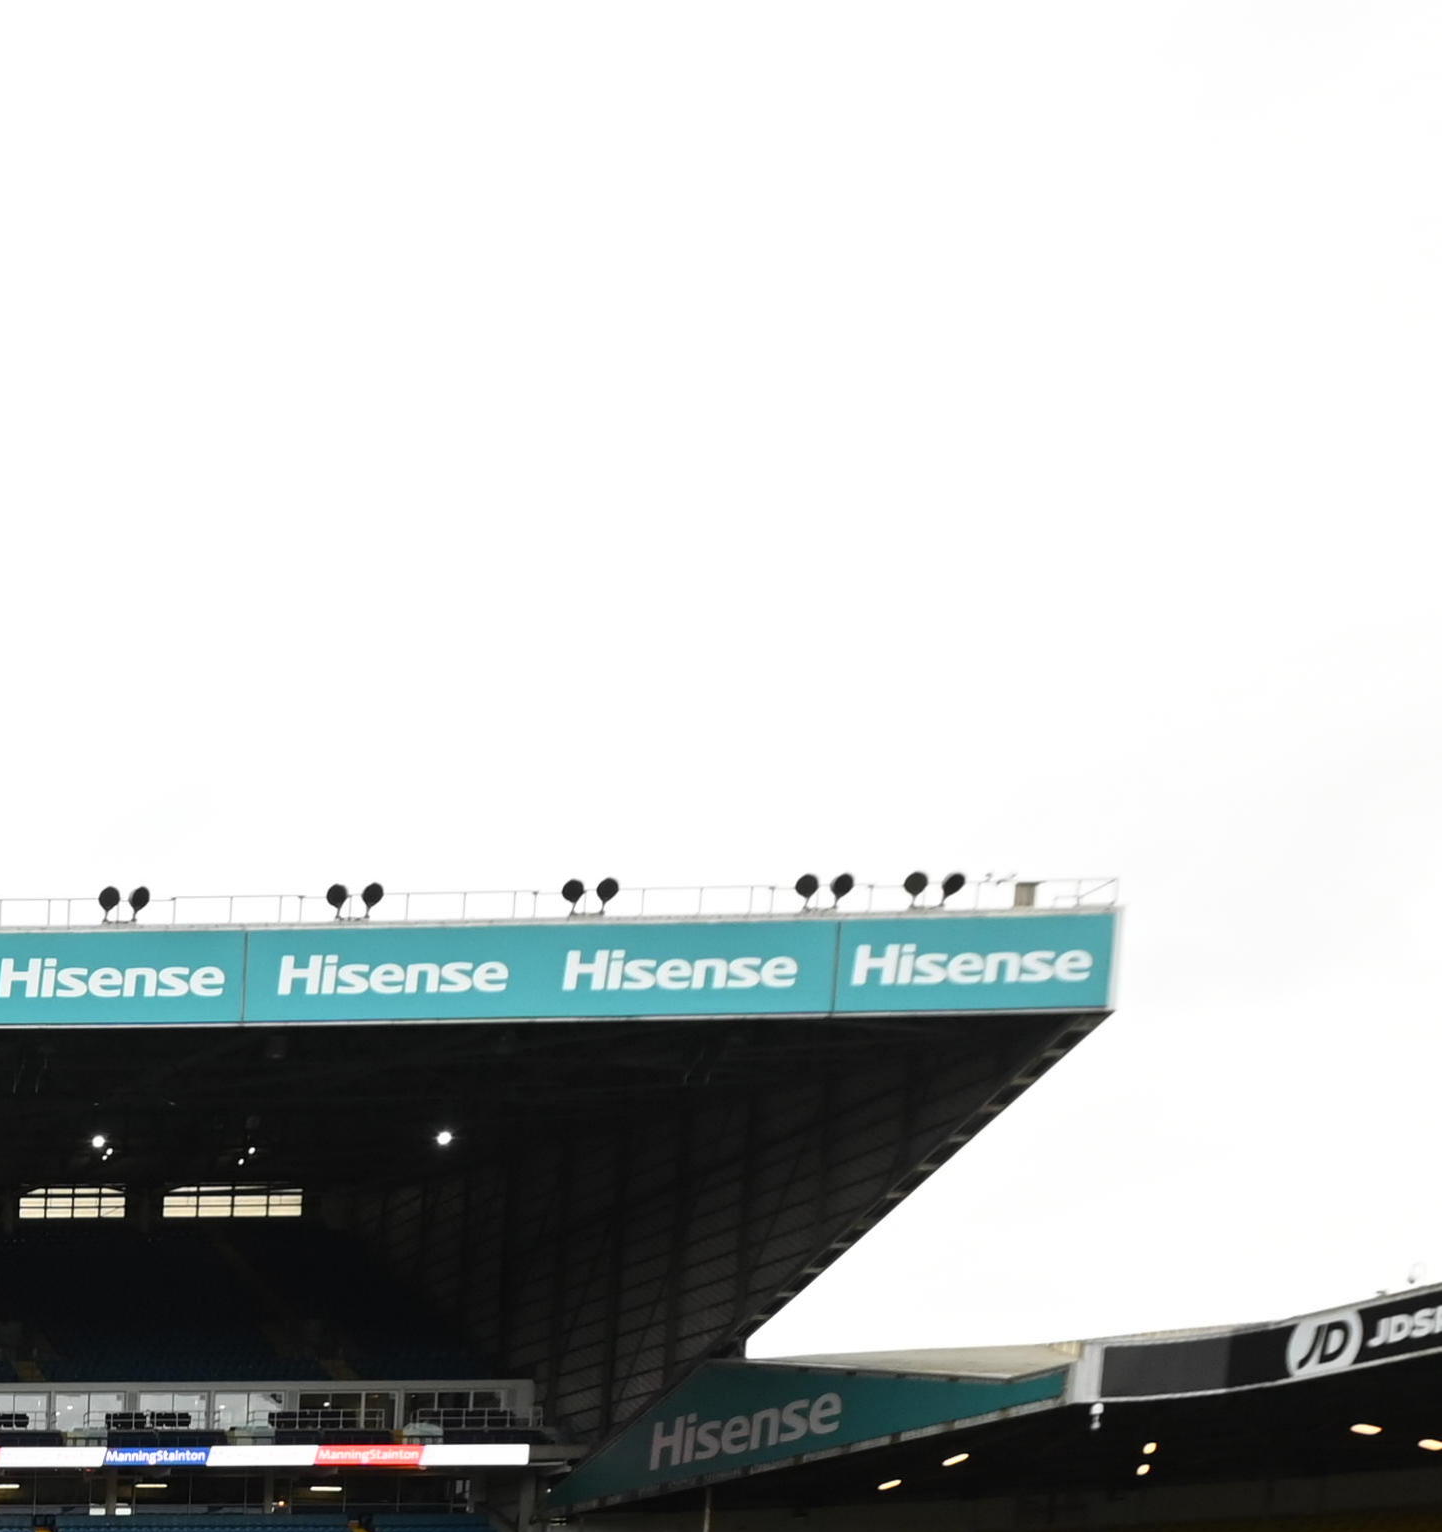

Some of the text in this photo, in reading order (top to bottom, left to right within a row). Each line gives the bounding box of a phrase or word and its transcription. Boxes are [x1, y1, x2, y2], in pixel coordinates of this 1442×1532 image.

[276, 954, 509, 996] Hisense
[561, 949, 799, 991] Hisense
[850, 943, 1093, 986] Hisense
[1296, 1320, 1352, 1371] JD
[648, 1391, 843, 1471] Hisense
